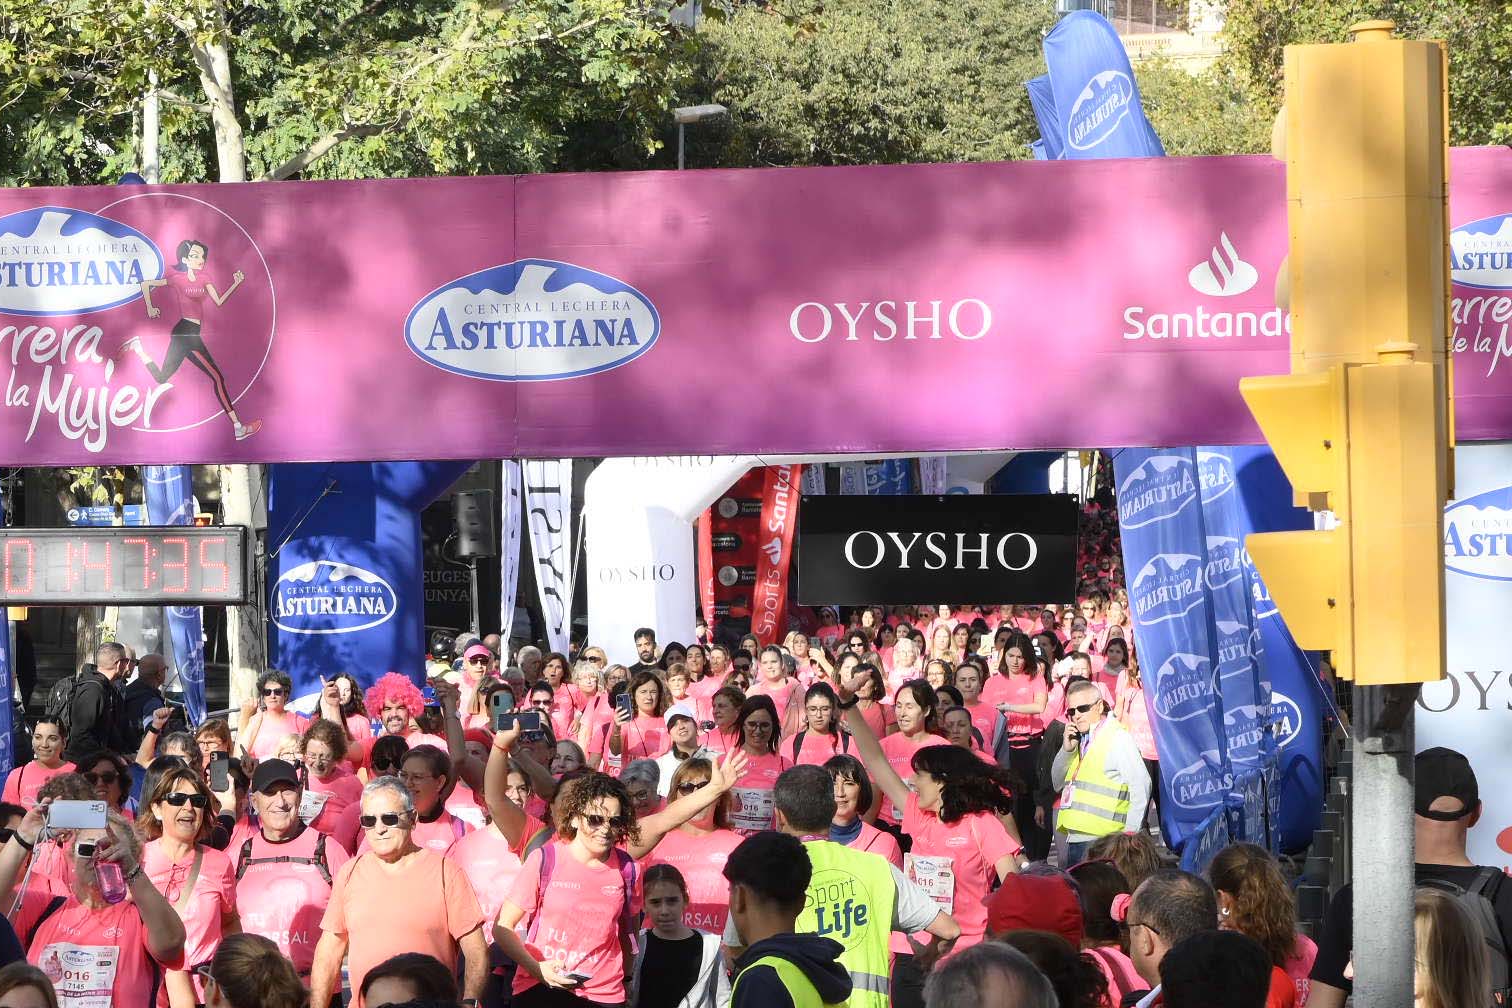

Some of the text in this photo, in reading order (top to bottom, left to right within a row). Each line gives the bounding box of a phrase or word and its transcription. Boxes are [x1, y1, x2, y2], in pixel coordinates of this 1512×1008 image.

[66, 242, 140, 255] LECHERA
[463, 300, 633, 314] CENTRAL LECHERA
[789, 297, 993, 343] OYSHO
[424, 305, 641, 352] ASTURIANA
[1473, 333, 1492, 354] la
[3, 368, 30, 408] la
[25, 360, 175, 454] Mujer
[4, 537, 229, 593] 01:47:35
[844, 530, 1038, 571] OYSHO
[274, 591, 388, 620] ASTURIANA
[287, 584, 383, 596] CENTRAL LECHERA
[756, 569, 781, 635] Sports
[814, 898, 868, 939] Life
[63, 970, 90, 981] 016
